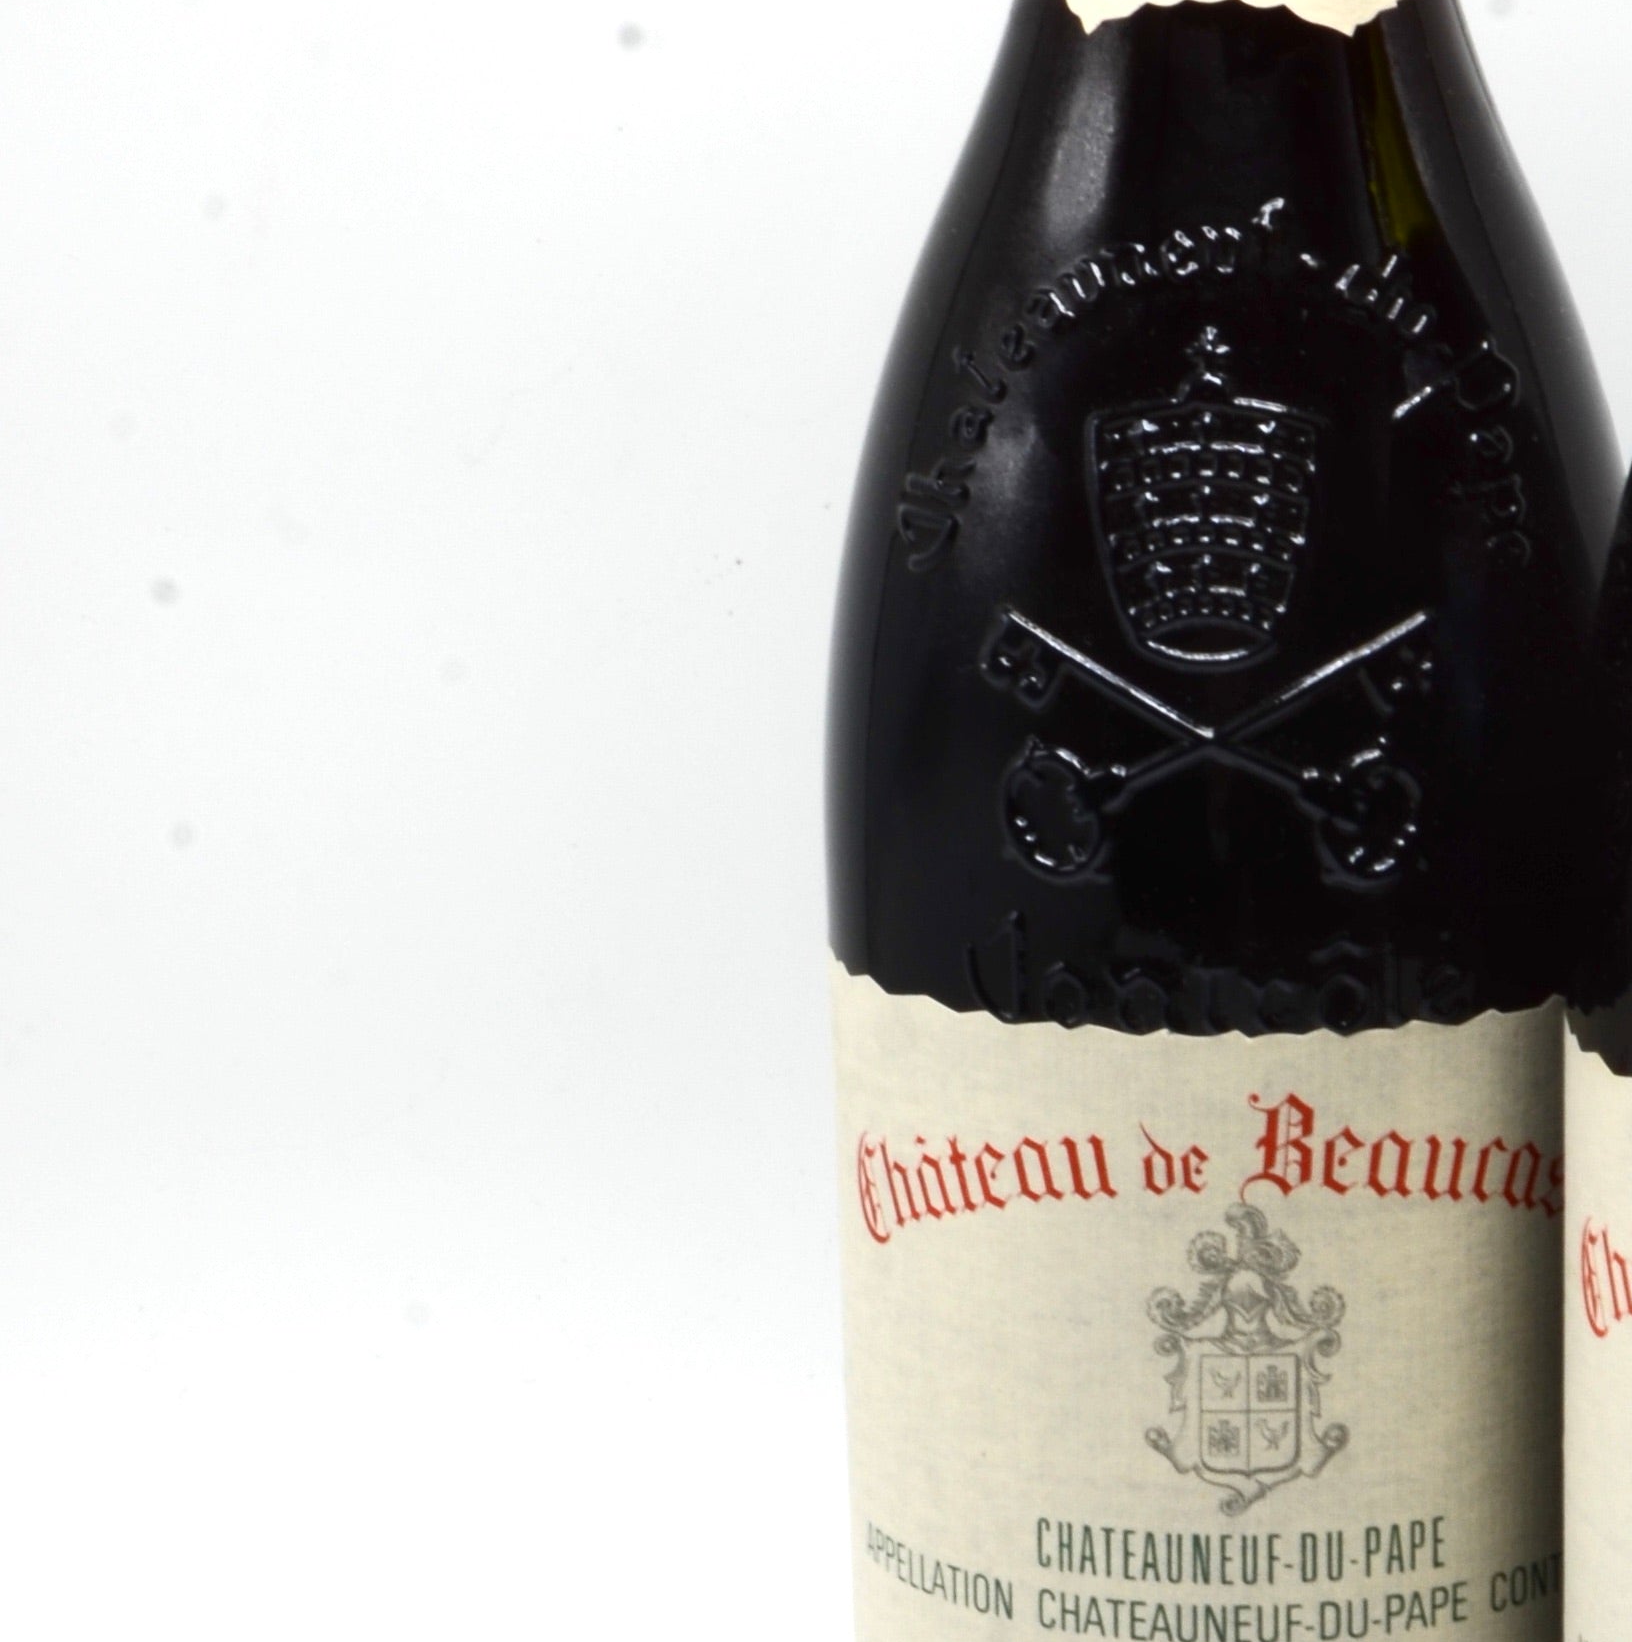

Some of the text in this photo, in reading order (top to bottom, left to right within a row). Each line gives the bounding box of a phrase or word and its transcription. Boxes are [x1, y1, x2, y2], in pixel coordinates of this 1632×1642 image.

[1139, 1120, 1209, 1197] de
[866, 1520, 1015, 1621] APPELLATION
[1036, 1516, 1446, 1586] CHATEAUNEUF-DU-PAPE
